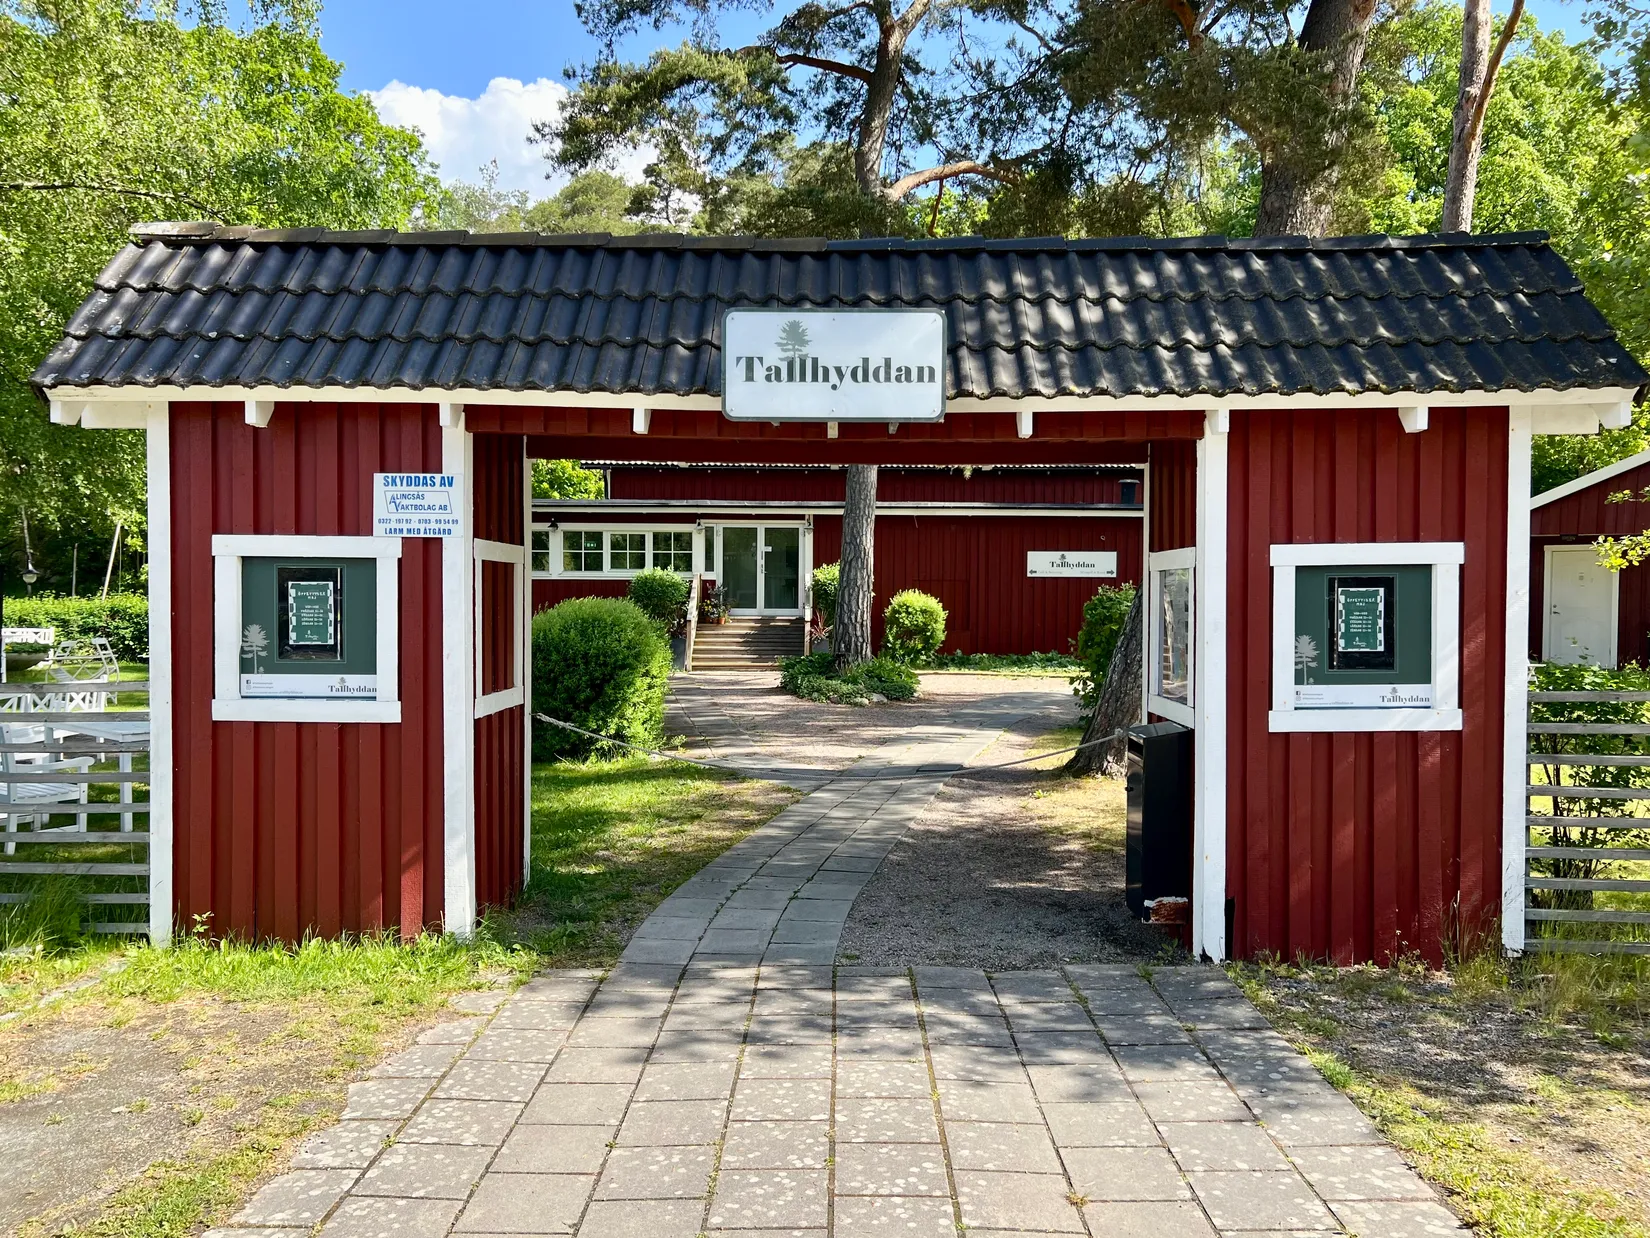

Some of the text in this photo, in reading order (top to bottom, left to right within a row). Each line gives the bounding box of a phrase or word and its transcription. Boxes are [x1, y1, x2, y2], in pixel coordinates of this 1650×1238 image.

[735, 356, 937, 391] Tallhyddan
[383, 475, 454, 487] SKYDDAS AV
[389, 491, 425, 504] ALINGSÅS
[392, 501, 436, 512] VAKTBOLAG
[384, 527, 404, 535] LARM
[406, 527, 421, 535] MED
[1049, 561, 1095, 569] Tallhyddan
[328, 685, 377, 694] Tallhyddan
[1379, 695, 1430, 704] Tallhyddan
